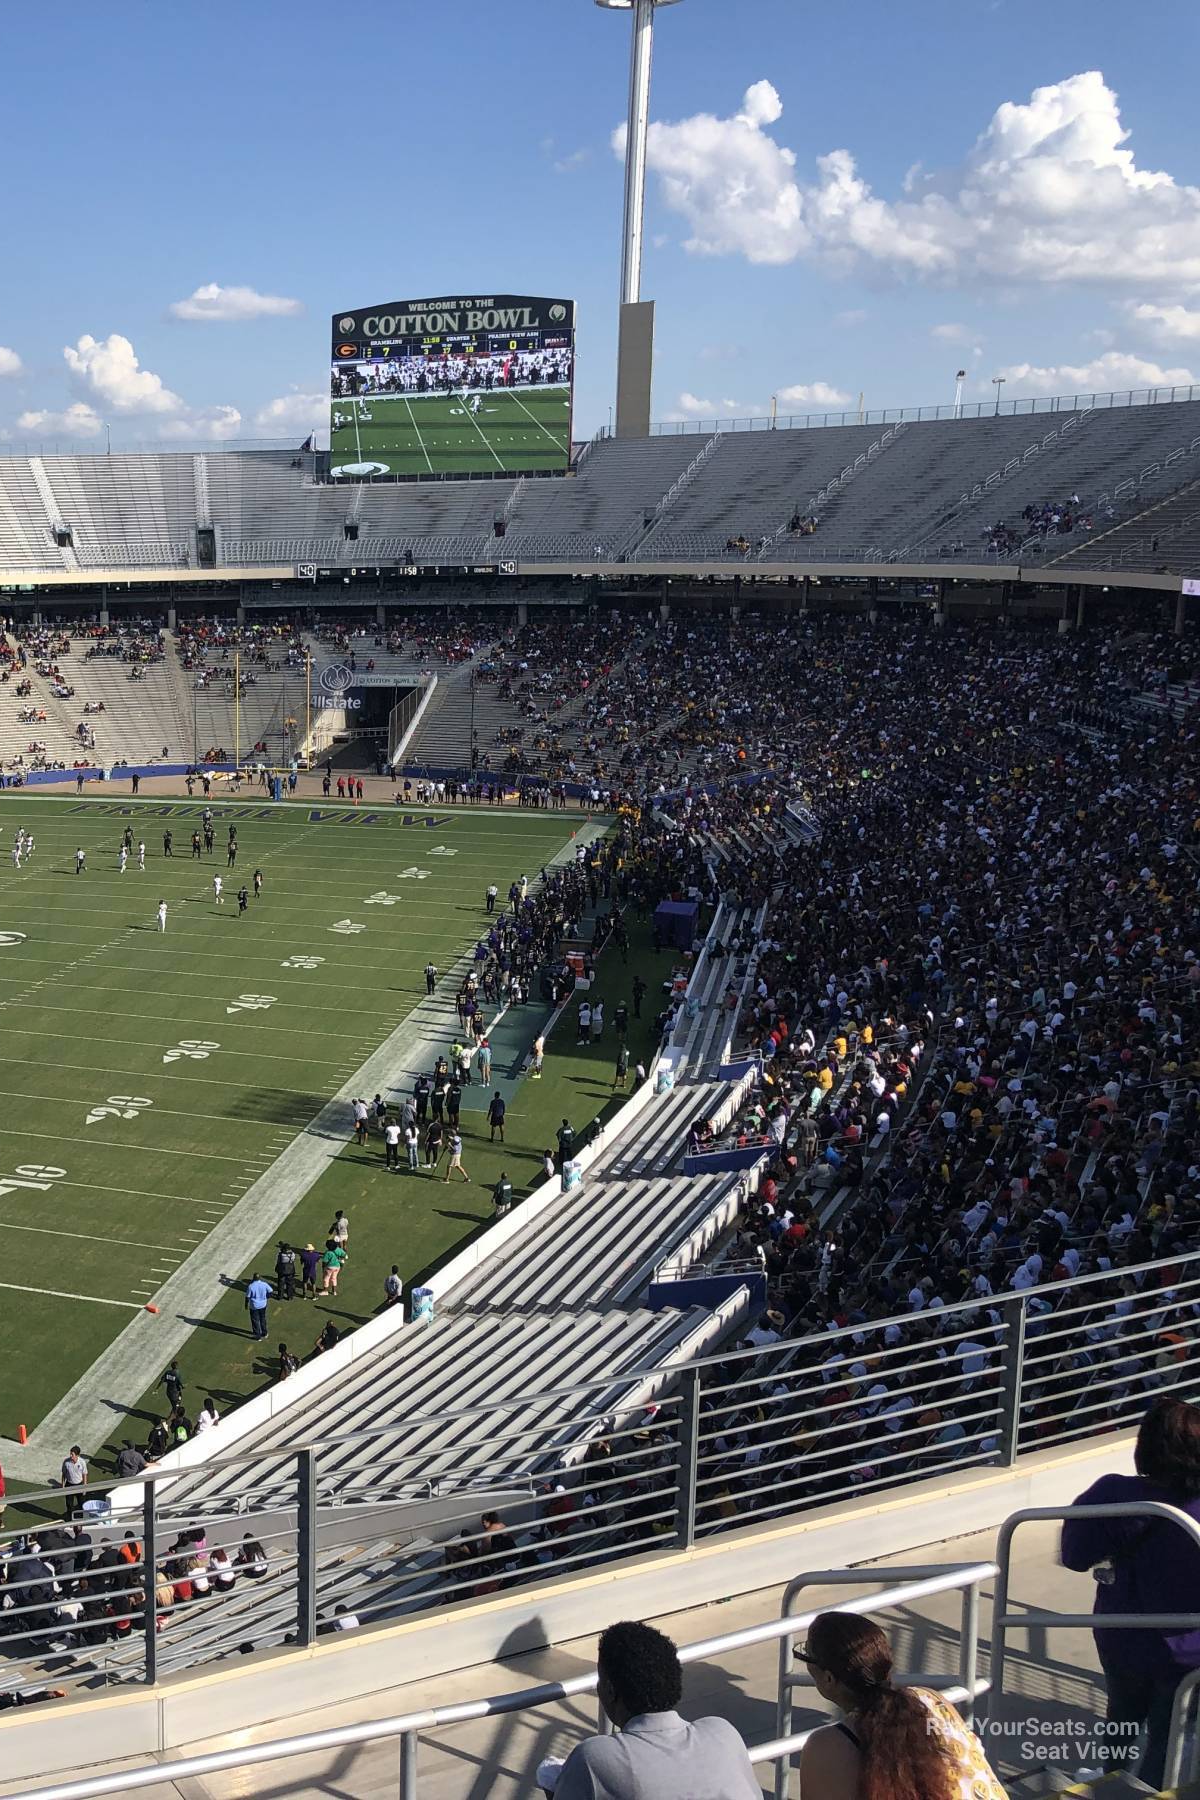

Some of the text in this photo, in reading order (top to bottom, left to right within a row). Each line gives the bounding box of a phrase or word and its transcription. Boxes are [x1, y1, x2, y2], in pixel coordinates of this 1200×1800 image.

[408, 299, 494, 312] WELCOME TO THE
[363, 307, 539, 337] COTTON BOWL
[383, 347, 390, 356] 7
[509, 340, 517, 350] 0
[300, 565, 314, 576] 40
[501, 562, 515, 573] 40
[65, 802, 456, 828] PRAIRIE VIEW
[280, 955, 326, 969] 50
[231, 994, 278, 1010] 40
[166, 1040, 221, 1059] 30
[91, 1095, 154, 1119] 20
